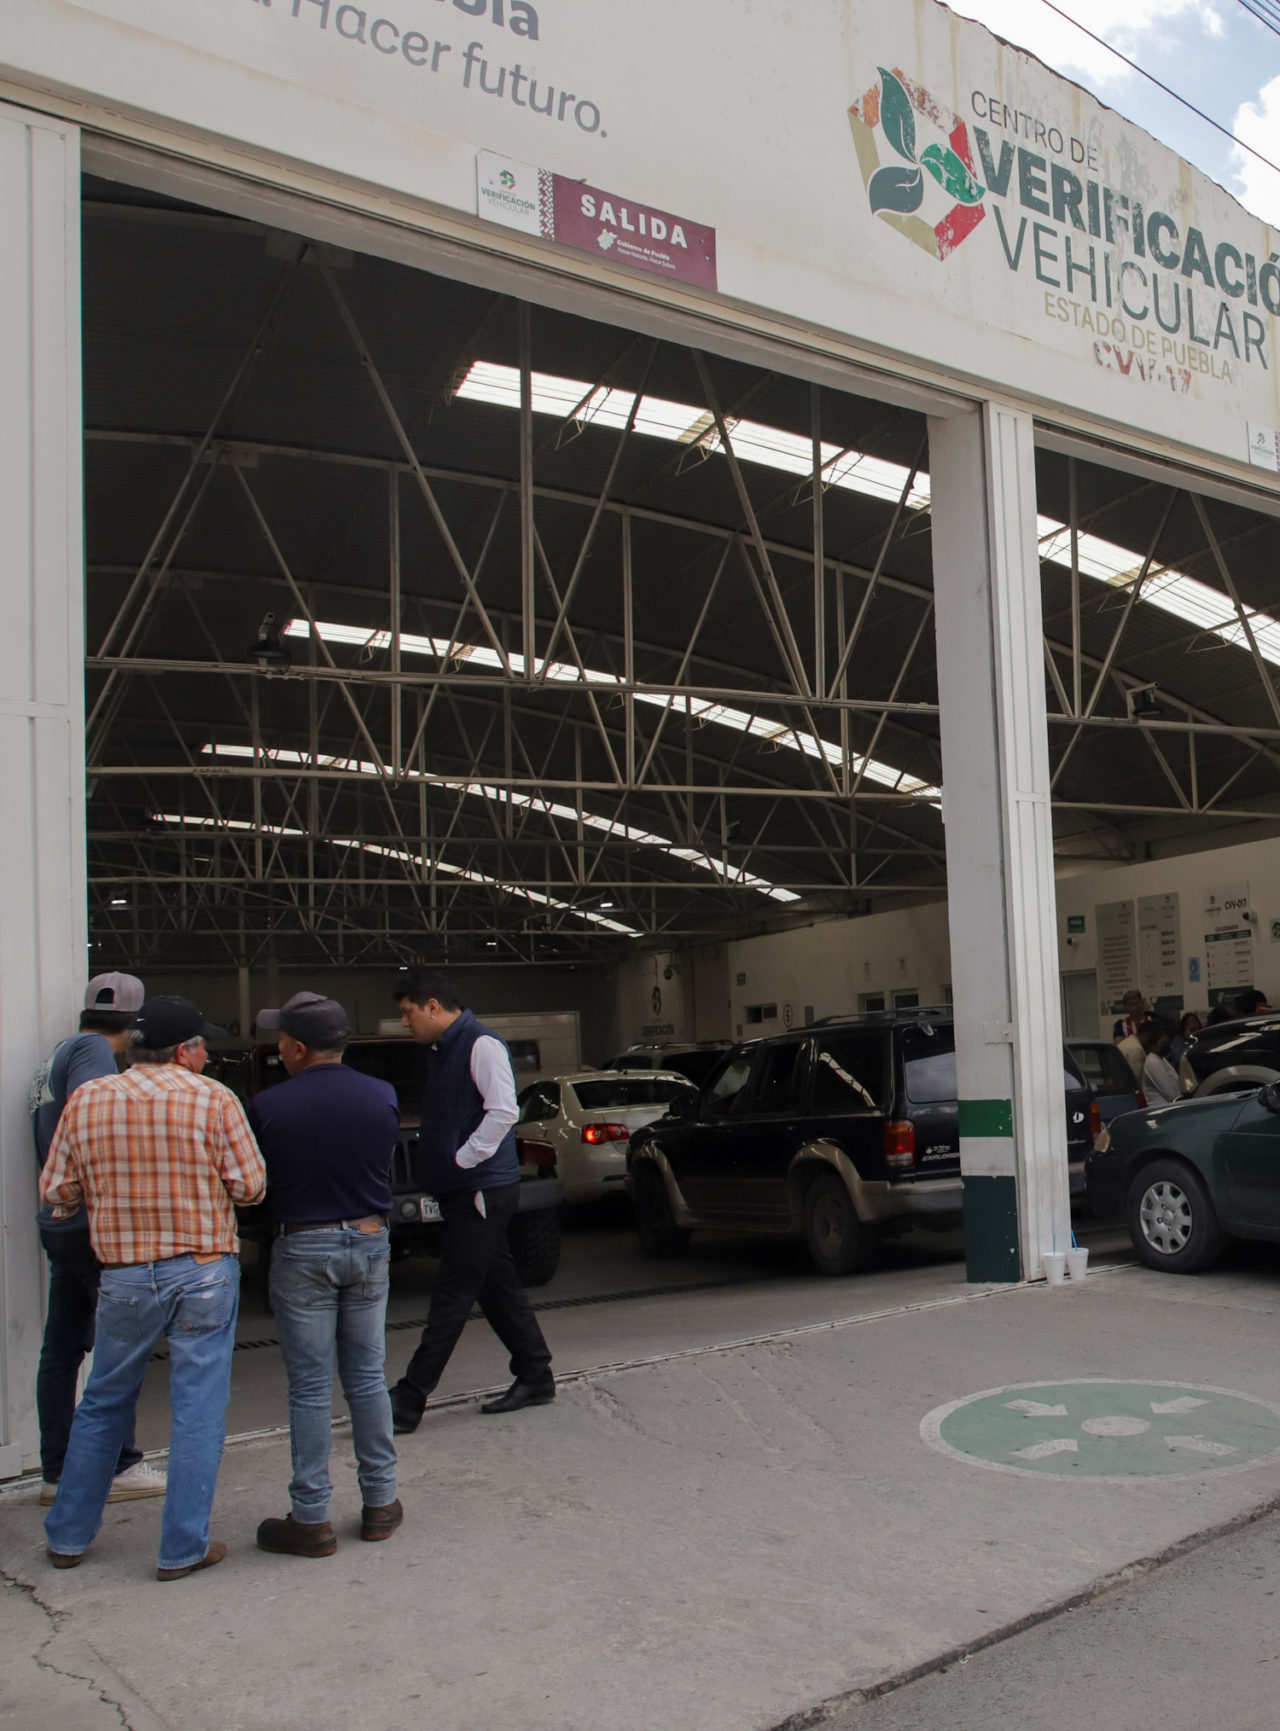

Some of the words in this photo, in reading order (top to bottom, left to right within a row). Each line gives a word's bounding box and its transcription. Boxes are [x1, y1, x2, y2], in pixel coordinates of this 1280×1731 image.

[462, 42, 608, 139] futuro.
[971, 91, 1064, 154] CENTRO
[1070, 136, 1099, 172] DE
[481, 186, 536, 211] VERIFICACIÓN
[580, 194, 688, 249] SALIDA
[992, 204, 1269, 370] VEHICULAR
[1044, 291, 1127, 343] ESTADO
[1131, 324, 1158, 355] DE
[1161, 336, 1233, 384] PUEBLA
